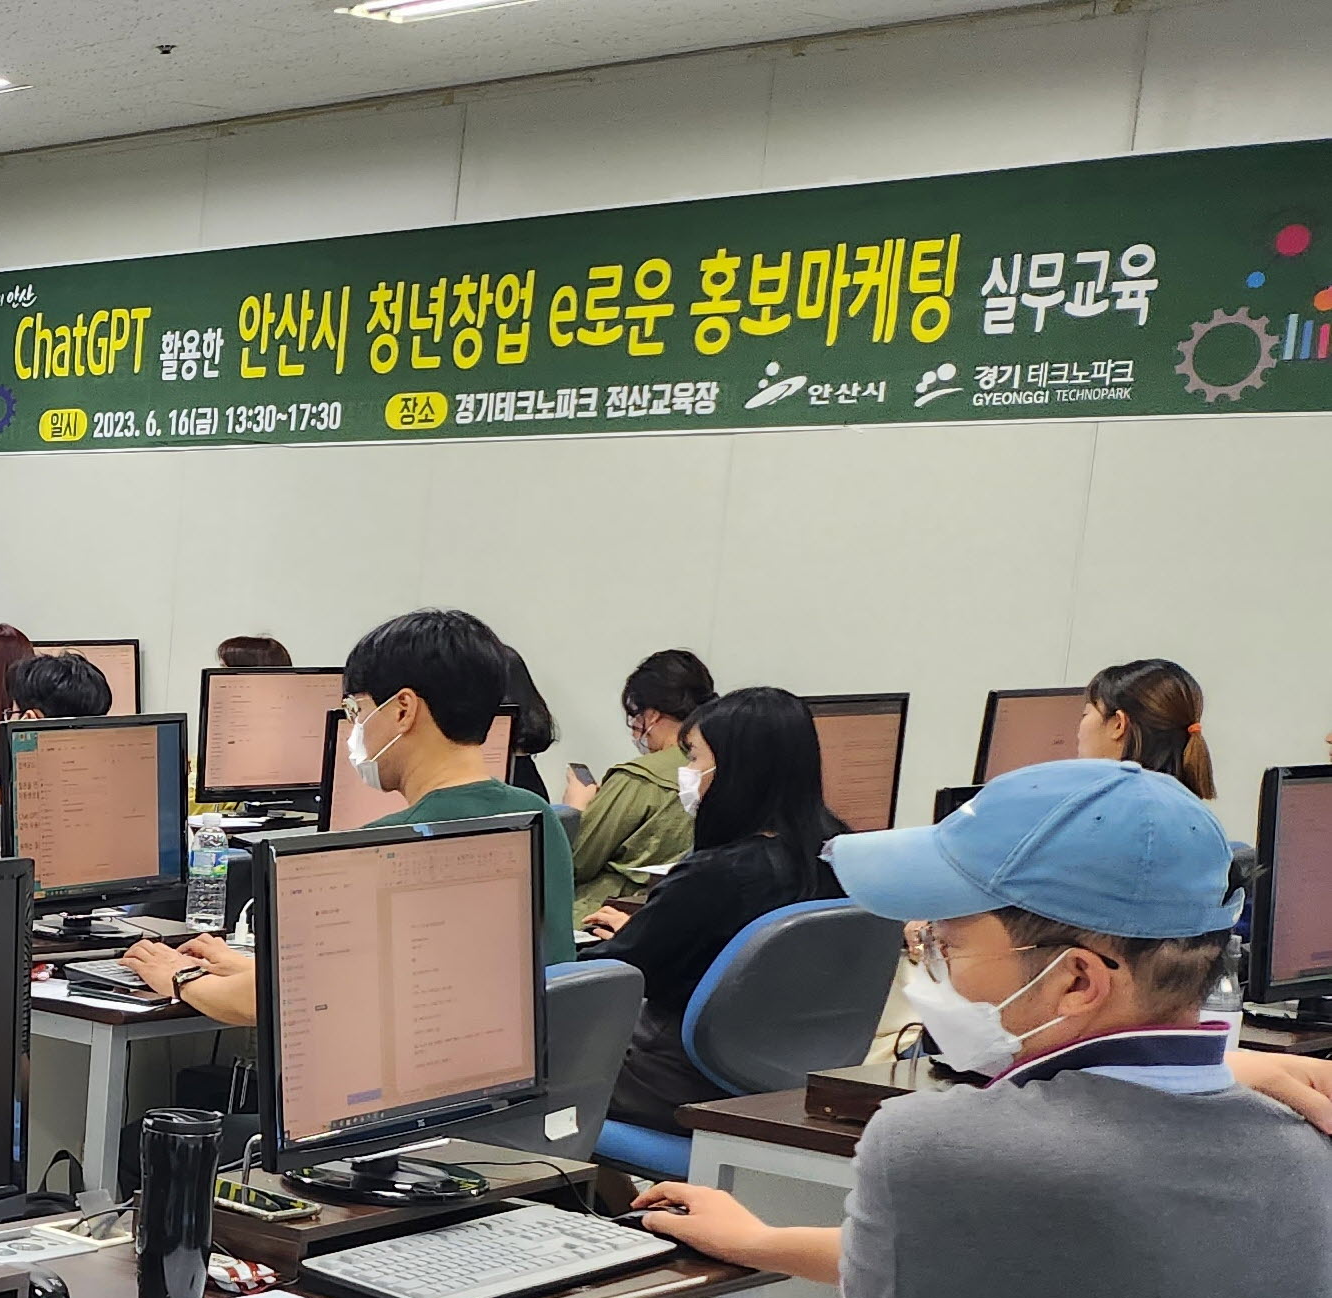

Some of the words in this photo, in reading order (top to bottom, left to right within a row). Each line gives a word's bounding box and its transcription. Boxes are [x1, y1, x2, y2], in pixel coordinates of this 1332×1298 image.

[6, 284, 37, 308] 안산
[14, 306, 152, 380] ChatGPT
[160, 327, 225, 381] 활용한
[238, 285, 350, 379] 안산시
[366, 269, 536, 374] 청년창업
[548, 257, 675, 357] e로운
[689, 233, 962, 355] 홍보마케팅
[980, 243, 1159, 335] 실무교육
[973, 363, 1022, 390] 경기
[1027, 358, 1135, 388] 테크노파크
[398, 396, 436, 425] 장소
[454, 386, 599, 424] 경기테크노파크
[606, 381, 720, 418] 전산교육장
[807, 380, 887, 405] 안산시
[972, 390, 1050, 406] GYEONGGI
[1055, 387, 1133, 402] TECHNOPARK
[50, 411, 79, 438] 일시
[93, 409, 140, 438] 2023.
[145, 410, 162, 437] 6.
[169, 407, 218, 436] 16(금)
[226, 401, 342, 434] 13:30~17:30
